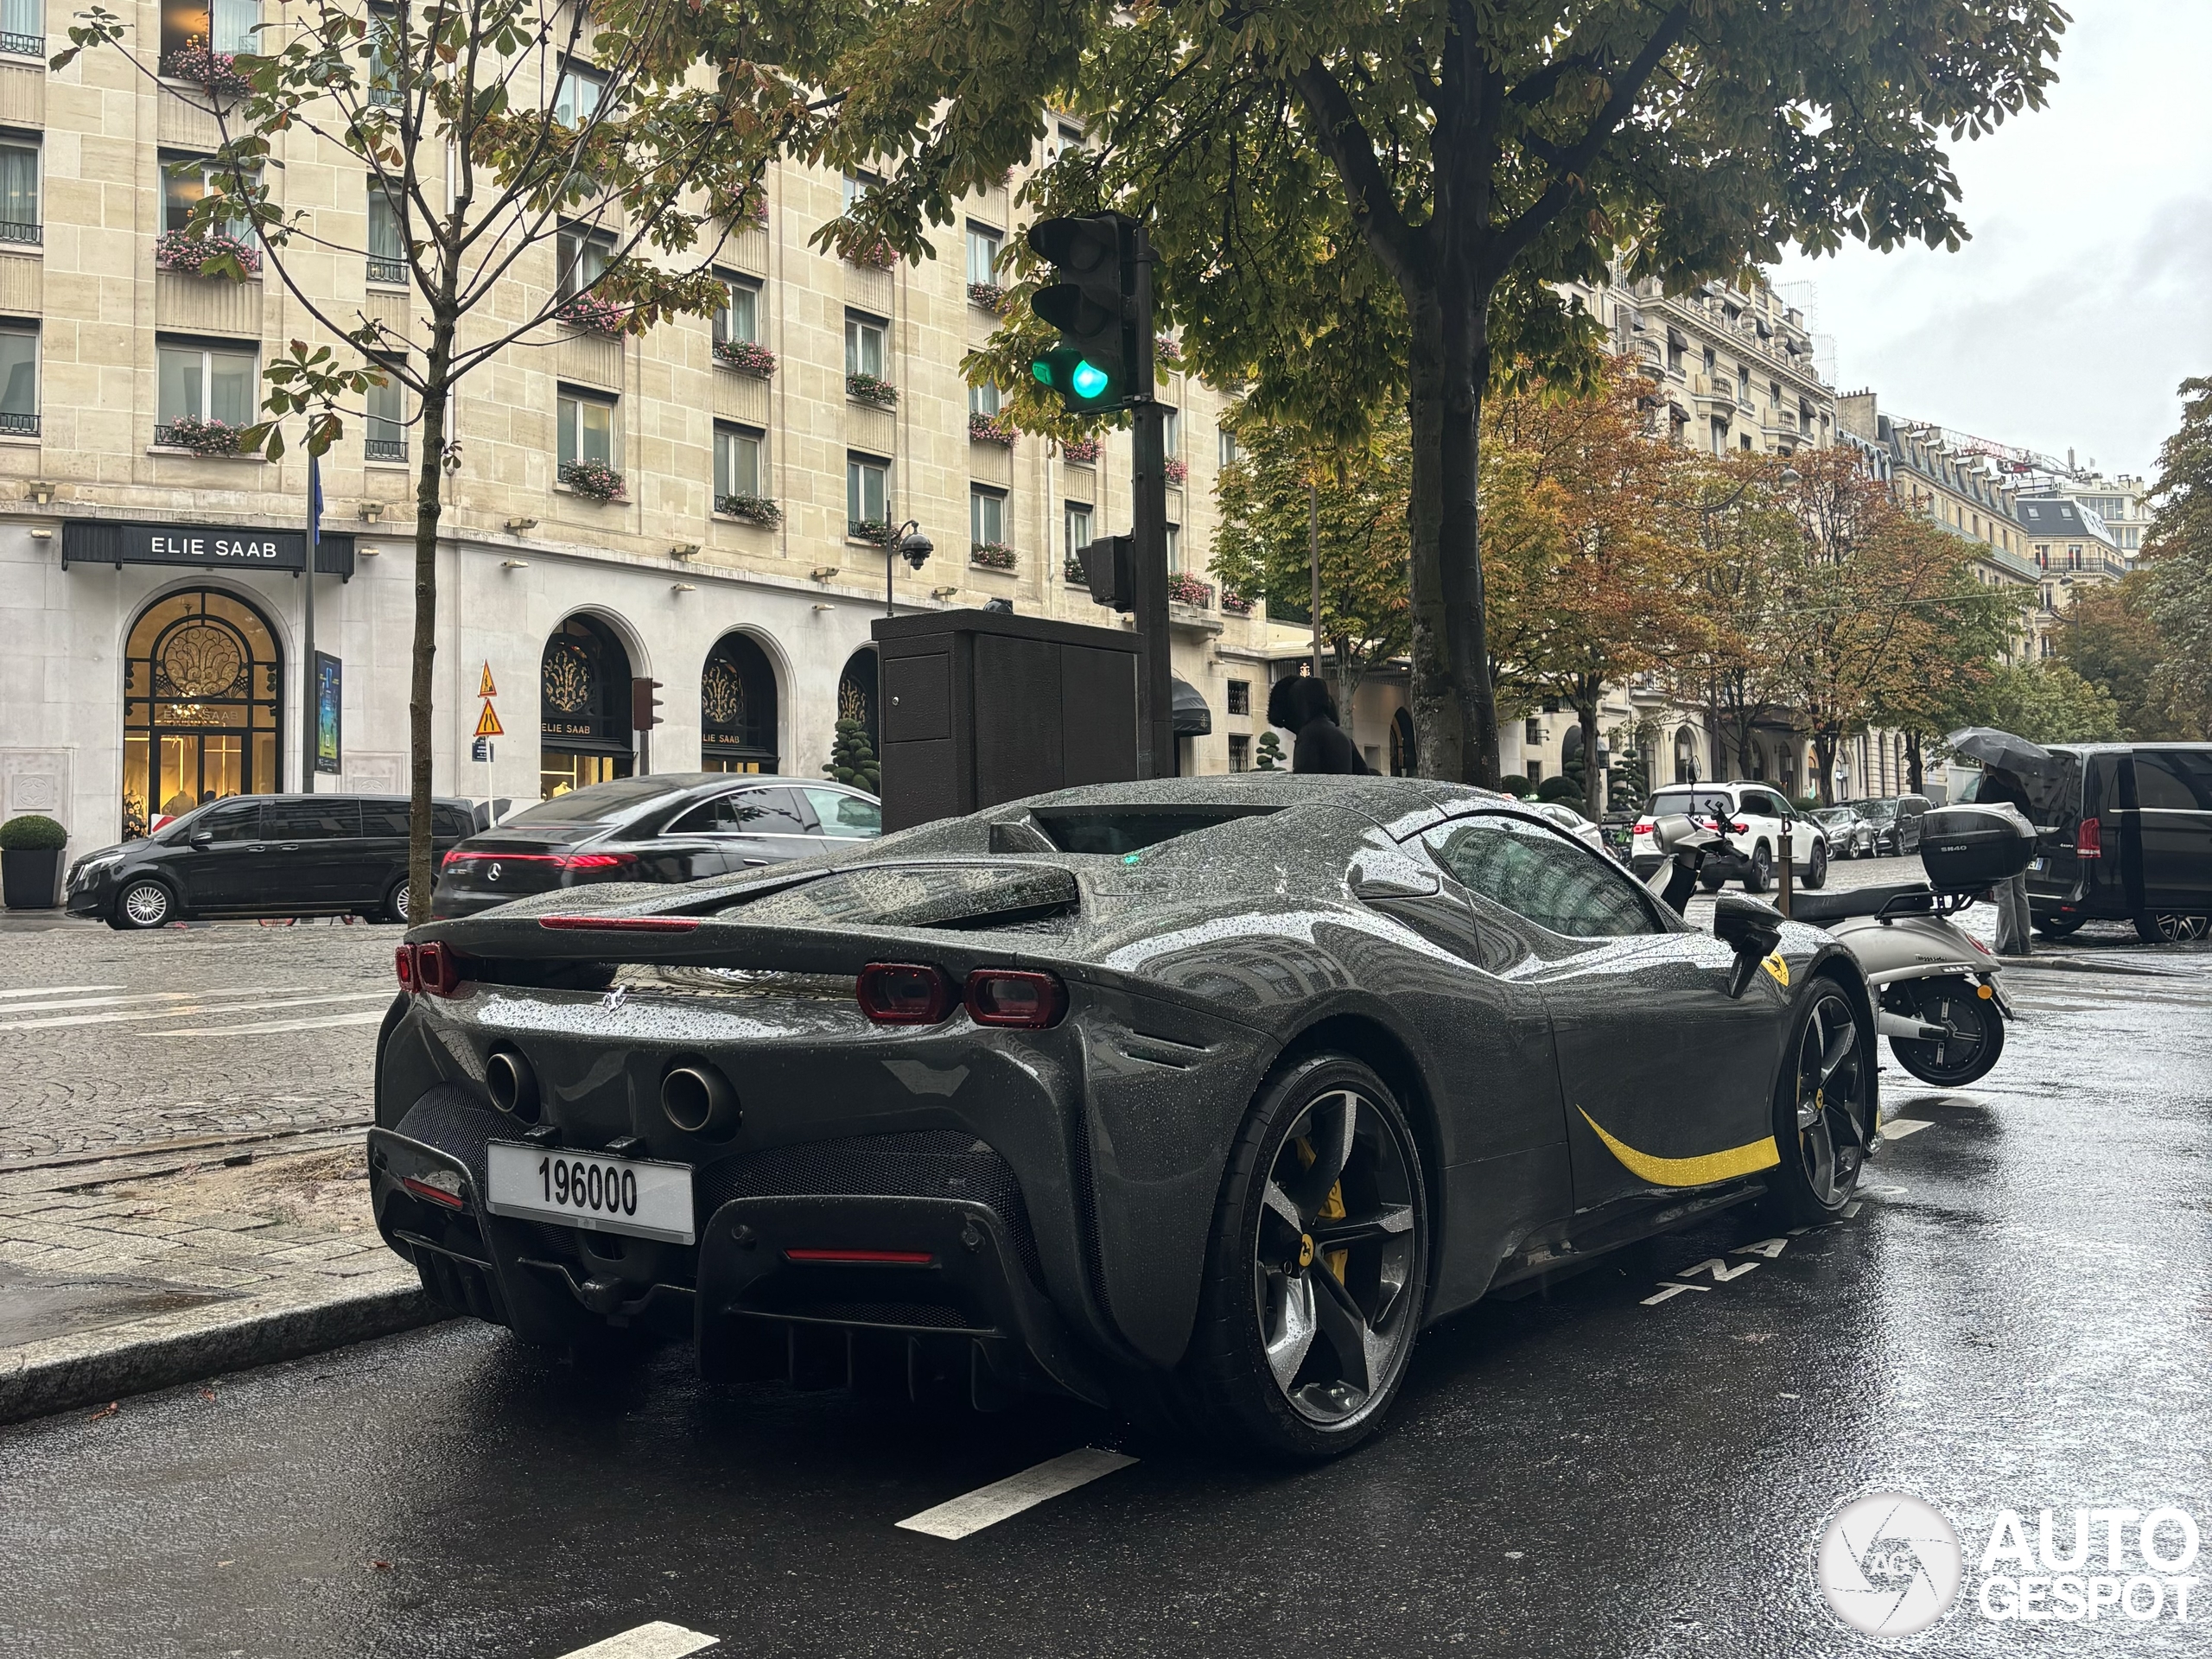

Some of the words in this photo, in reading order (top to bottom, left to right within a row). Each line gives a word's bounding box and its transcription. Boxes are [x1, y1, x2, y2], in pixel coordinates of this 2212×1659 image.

[151, 537, 205, 555] ELIE
[215, 540, 276, 558] SAAB
[203, 709, 238, 721] SAAB
[541, 722, 563, 733] ELIE
[566, 724, 591, 734] SAAB
[702, 734, 716, 742] LIE
[719, 734, 740, 744] SAAB
[539, 1156, 638, 1217] 196000
